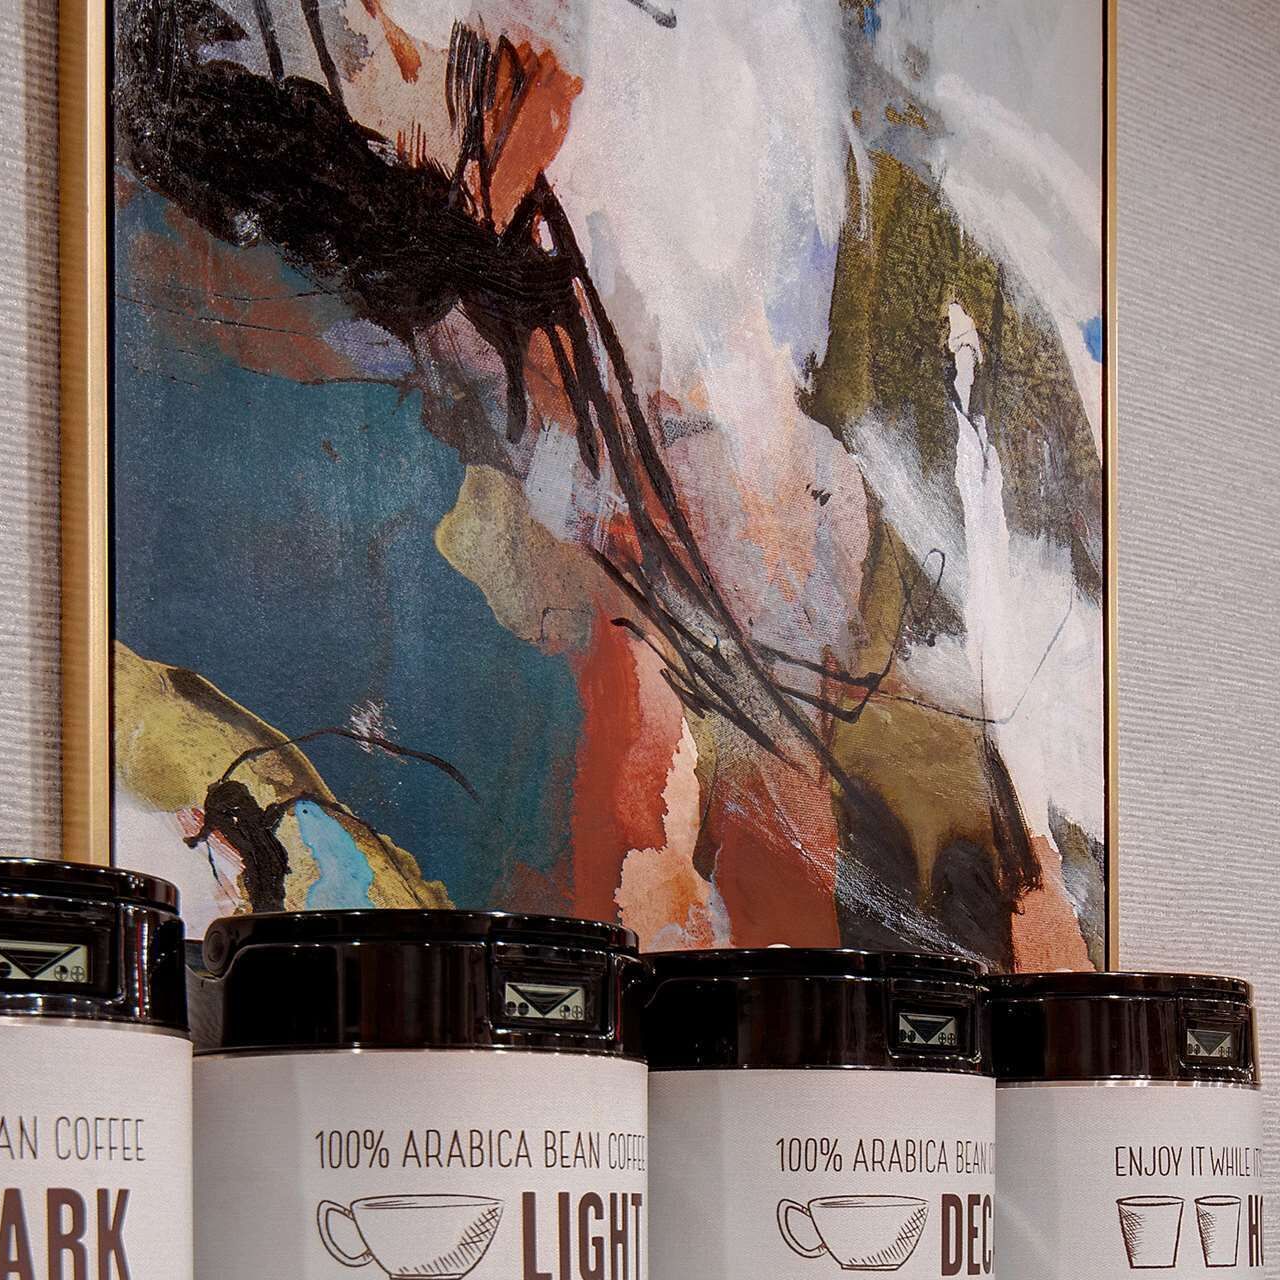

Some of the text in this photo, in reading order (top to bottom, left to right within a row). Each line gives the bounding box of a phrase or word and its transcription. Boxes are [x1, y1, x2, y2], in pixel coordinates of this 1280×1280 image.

[55, 1116, 146, 1161] COFFEE
[315, 1129, 645, 1171] 100% ARABICA BEAN COFFEE
[776, 1137, 842, 1172] 100%
[853, 1138, 948, 1173] ARABICA
[956, 1141, 986, 1174] BEAN
[1116, 1147, 1182, 1177] ENJOY
[1191, 1146, 1205, 1177] IT
[1211, 1146, 1250, 1177] WHILE
[941, 1193, 995, 1276] DEC
[1248, 1195, 1264, 1267] H
